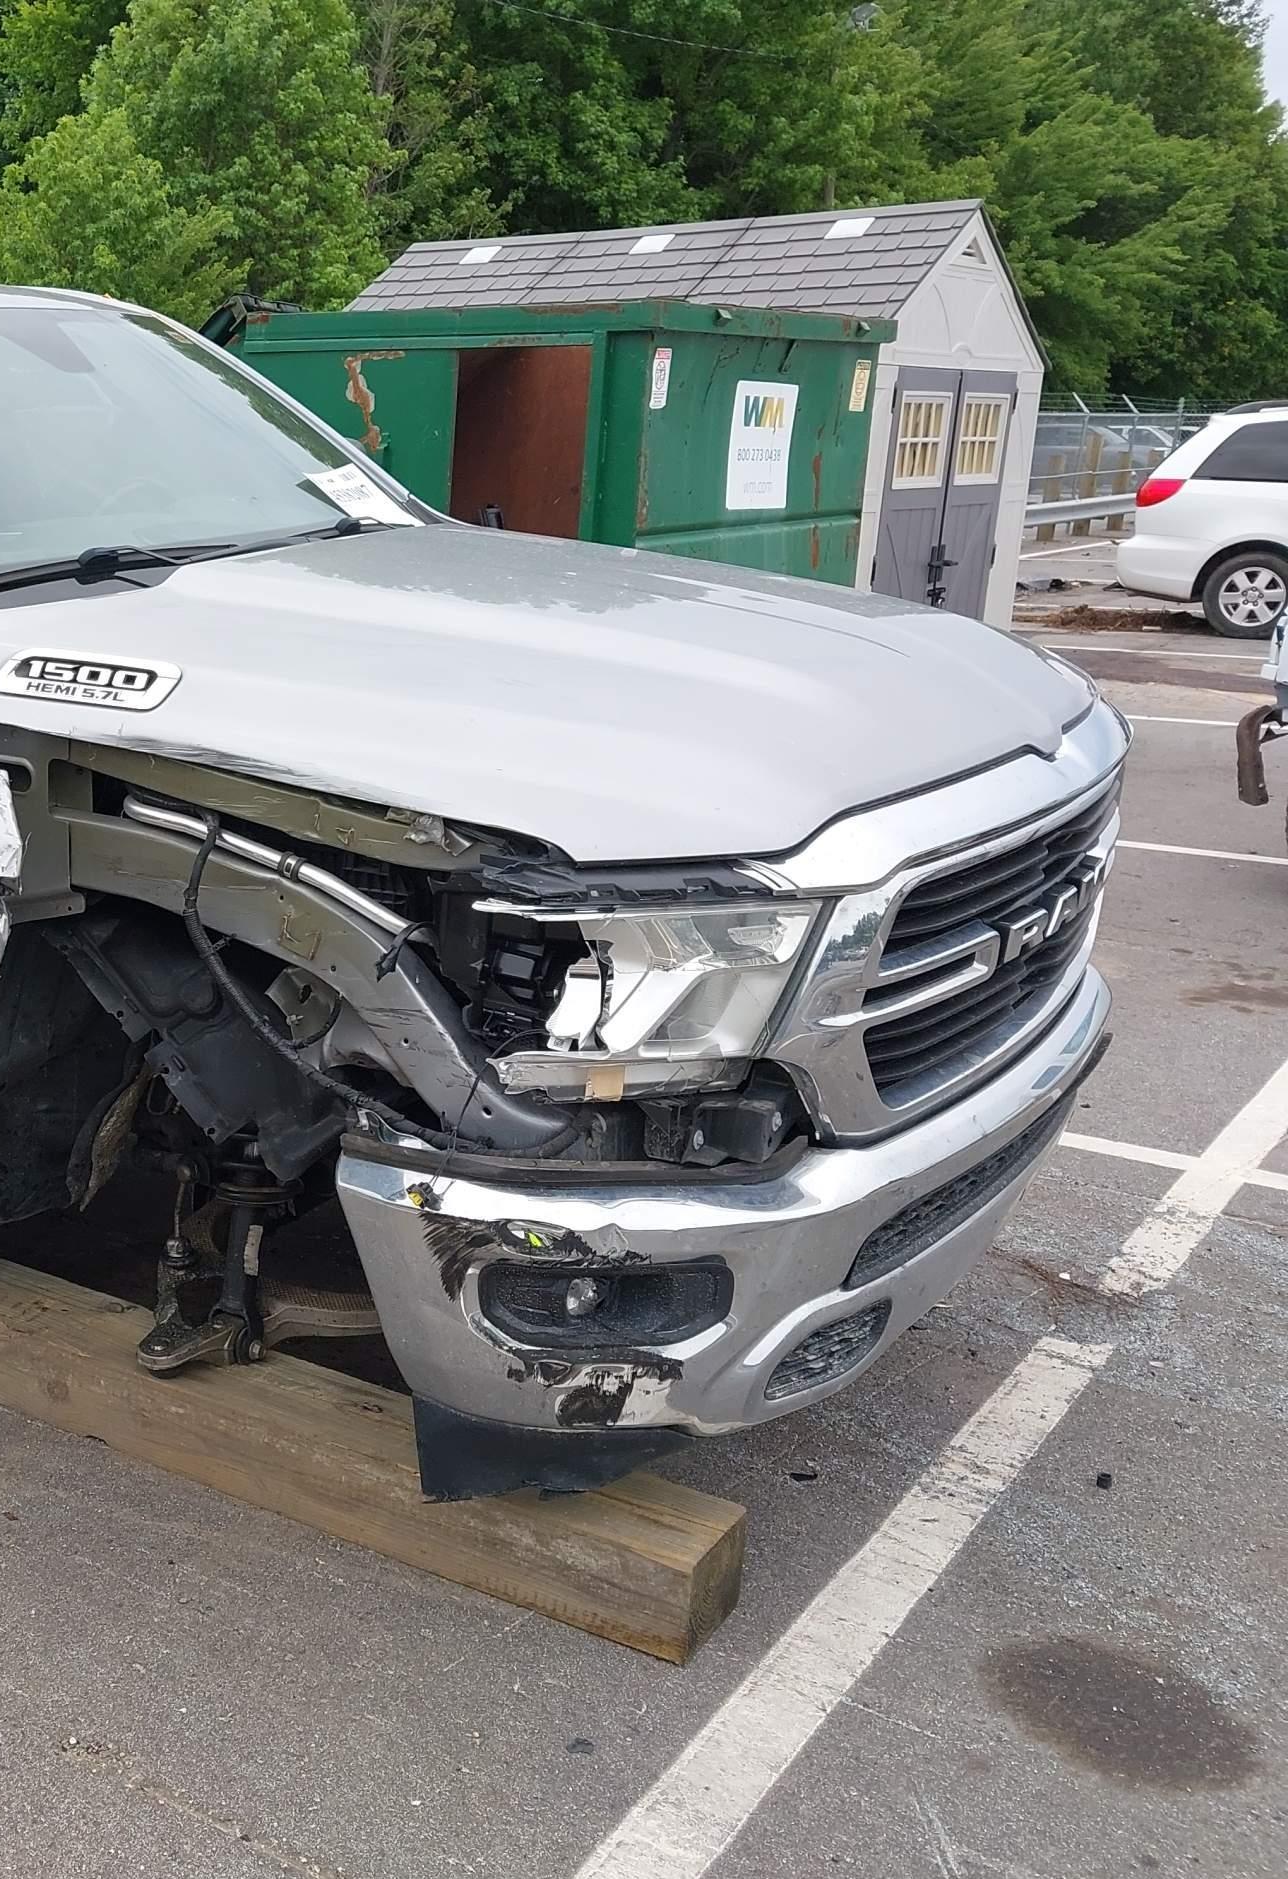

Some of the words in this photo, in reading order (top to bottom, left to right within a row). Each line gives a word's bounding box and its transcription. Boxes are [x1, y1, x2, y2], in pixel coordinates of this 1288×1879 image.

[743, 395, 785, 428] WM
[751, 448, 764, 461] 273
[28, 659, 149, 691] 1500
[25, 681, 76, 697] HEMI
[81, 687, 125, 702] 5.7L
